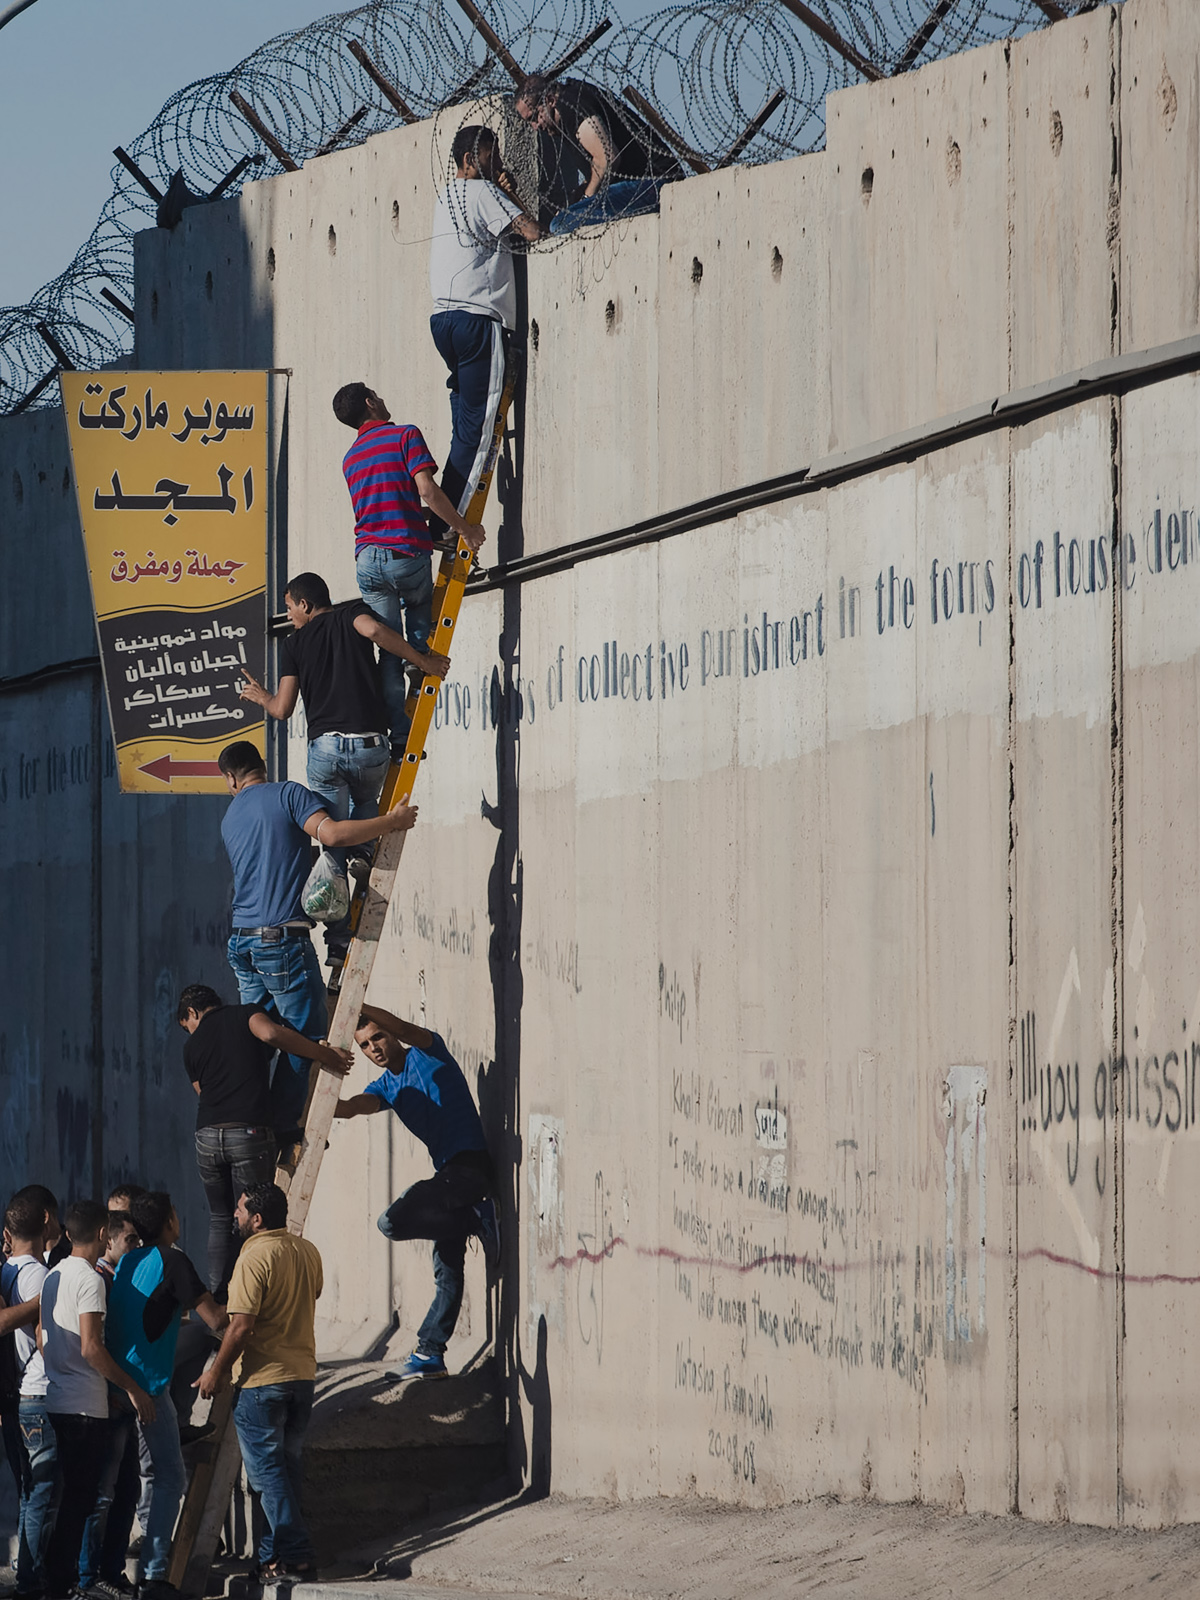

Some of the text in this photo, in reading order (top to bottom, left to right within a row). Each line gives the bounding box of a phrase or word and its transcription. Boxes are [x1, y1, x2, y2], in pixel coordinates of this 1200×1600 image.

[78, 382, 255, 445] سوبر ماركت
[94, 463, 254, 526] المجد
[111, 550, 246, 584] جملة ومفرق
[114, 620, 247, 654] مواد تموينية
[578, 639, 690, 703] collective
[701, 592, 825, 687] punishment
[838, 576, 862, 639] in
[874, 565, 915, 635] the
[1017, 538, 1044, 609] of
[1053, 531, 1136, 598] house
[125, 641, 248, 683] أجبان وألبان
[123, 684, 211, 710] سكاكر
[148, 704, 245, 729] مكسرات
[708, 1428, 757, 1485] 20.08.08
